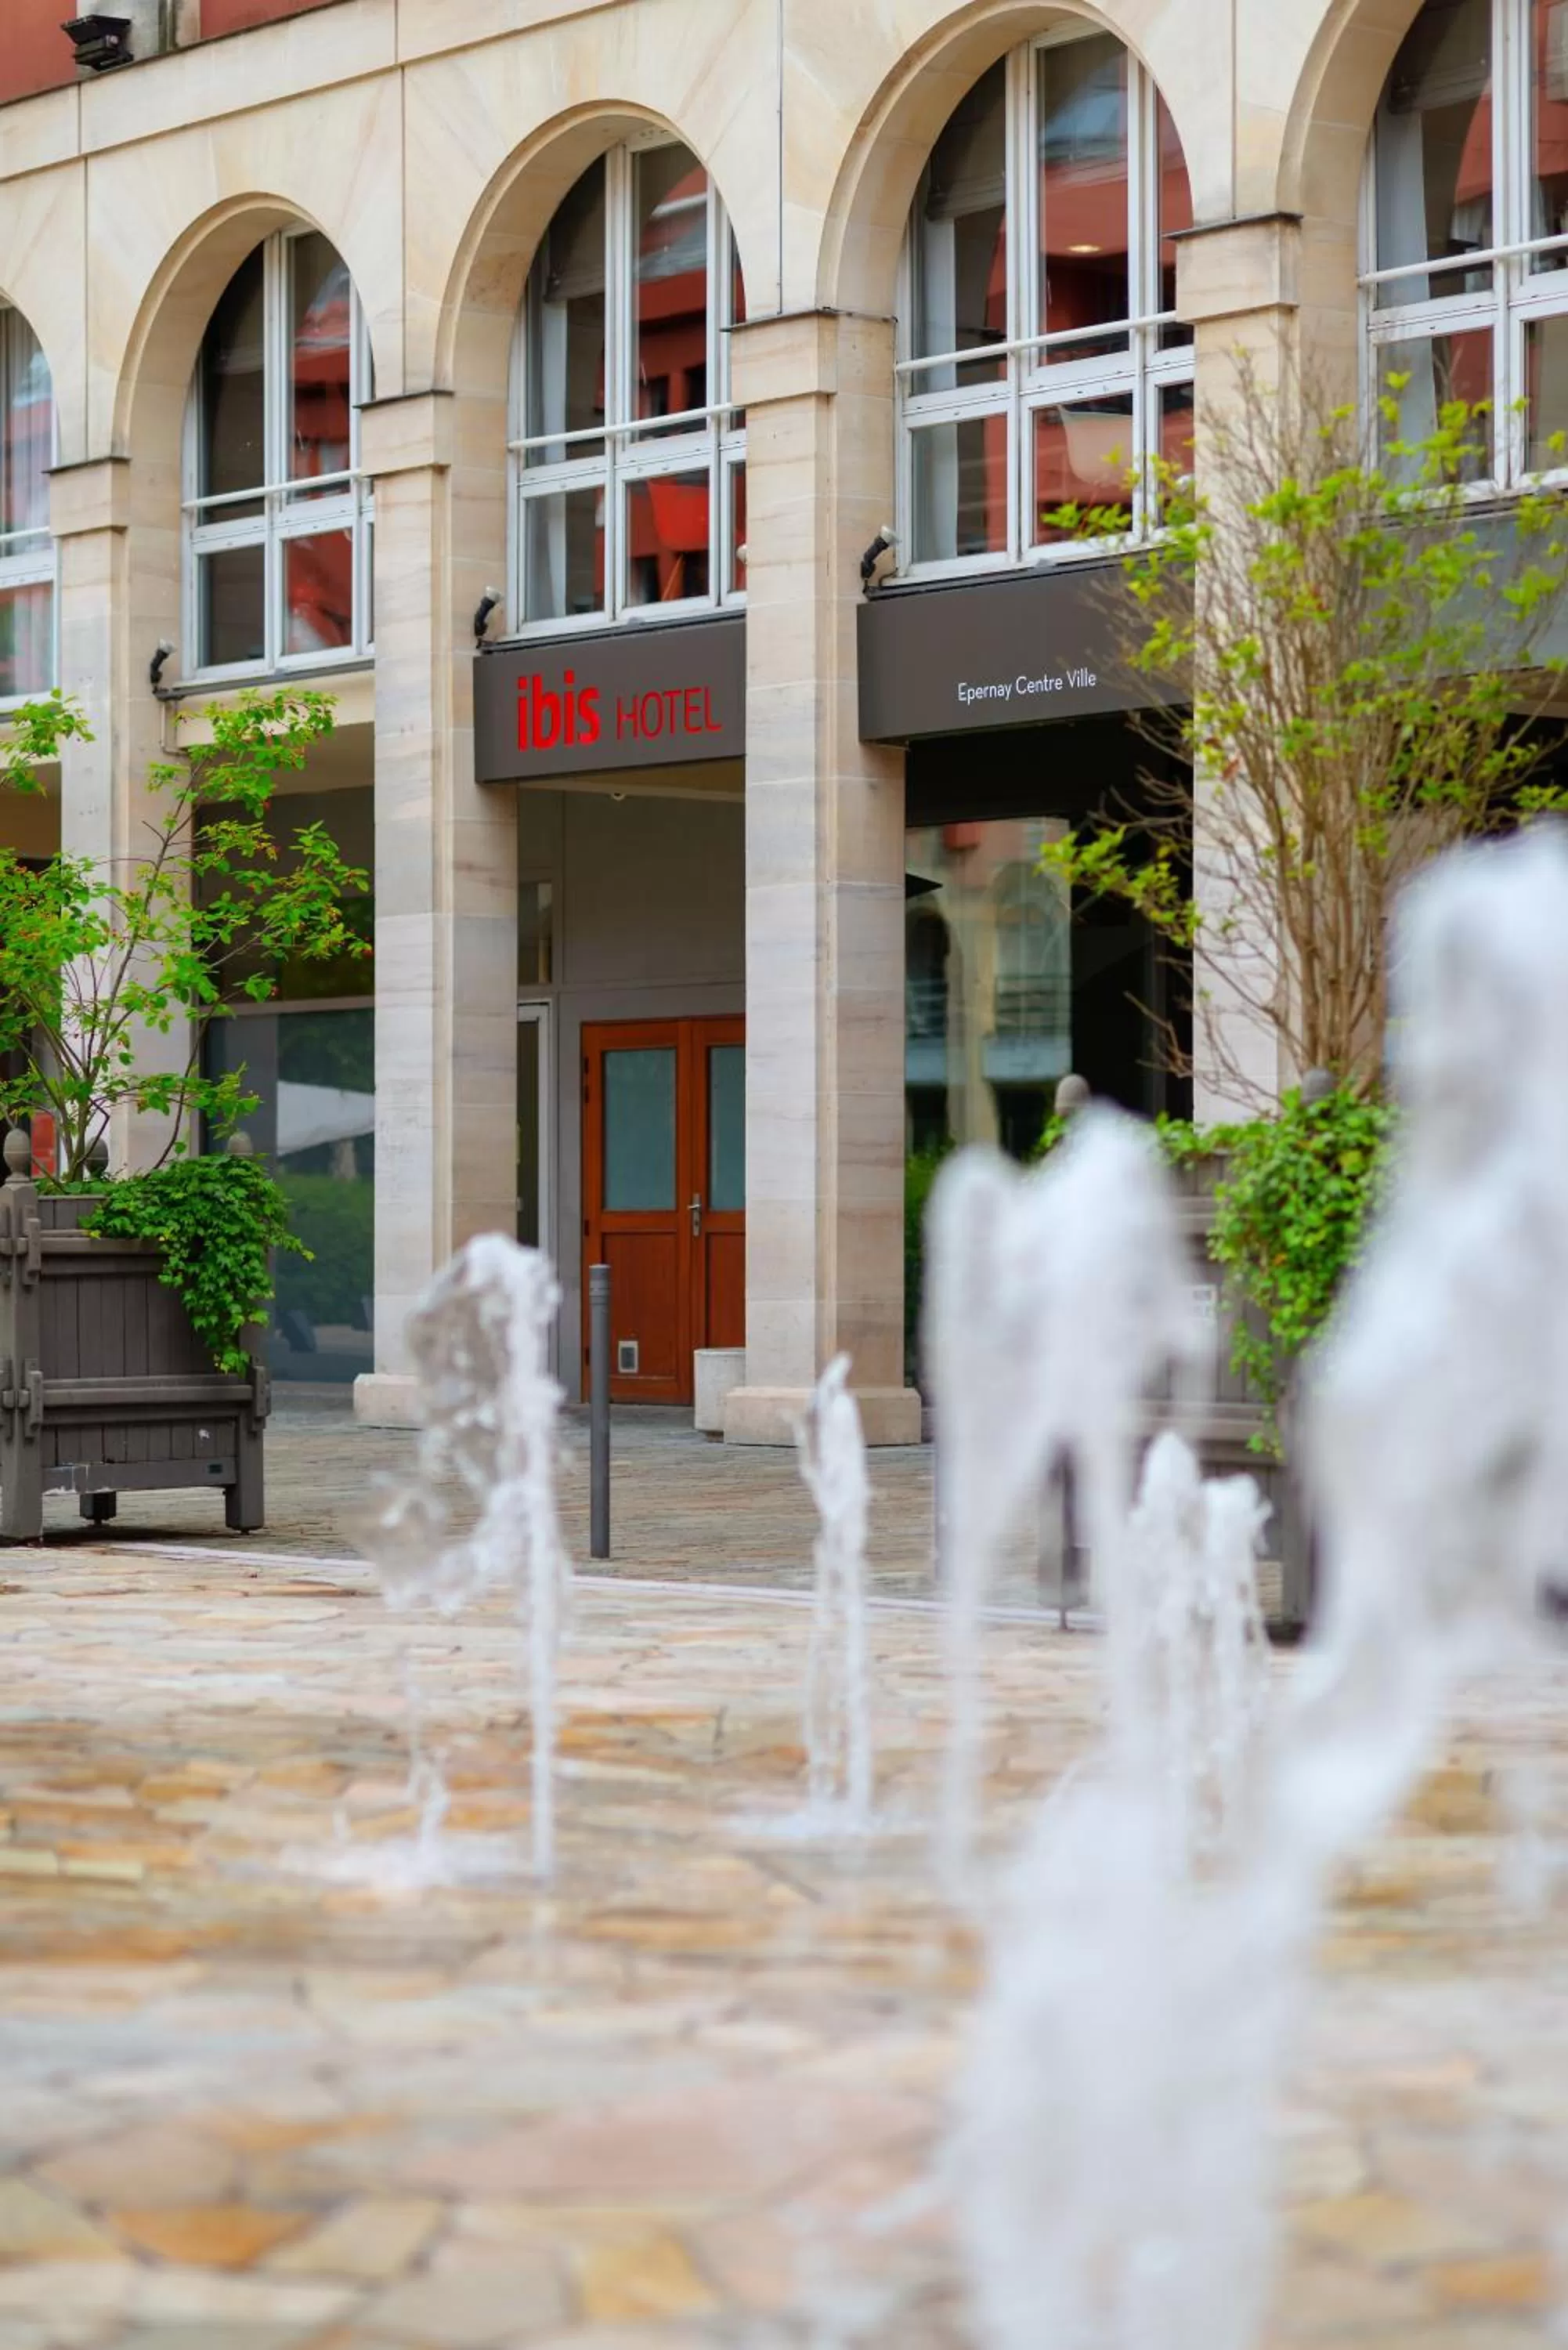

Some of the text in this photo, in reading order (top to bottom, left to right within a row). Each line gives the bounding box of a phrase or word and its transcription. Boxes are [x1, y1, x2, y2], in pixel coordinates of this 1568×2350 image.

[517, 670, 722, 752] ibis HOTEL
[957, 667, 1097, 706] Epernay Centre Ville
